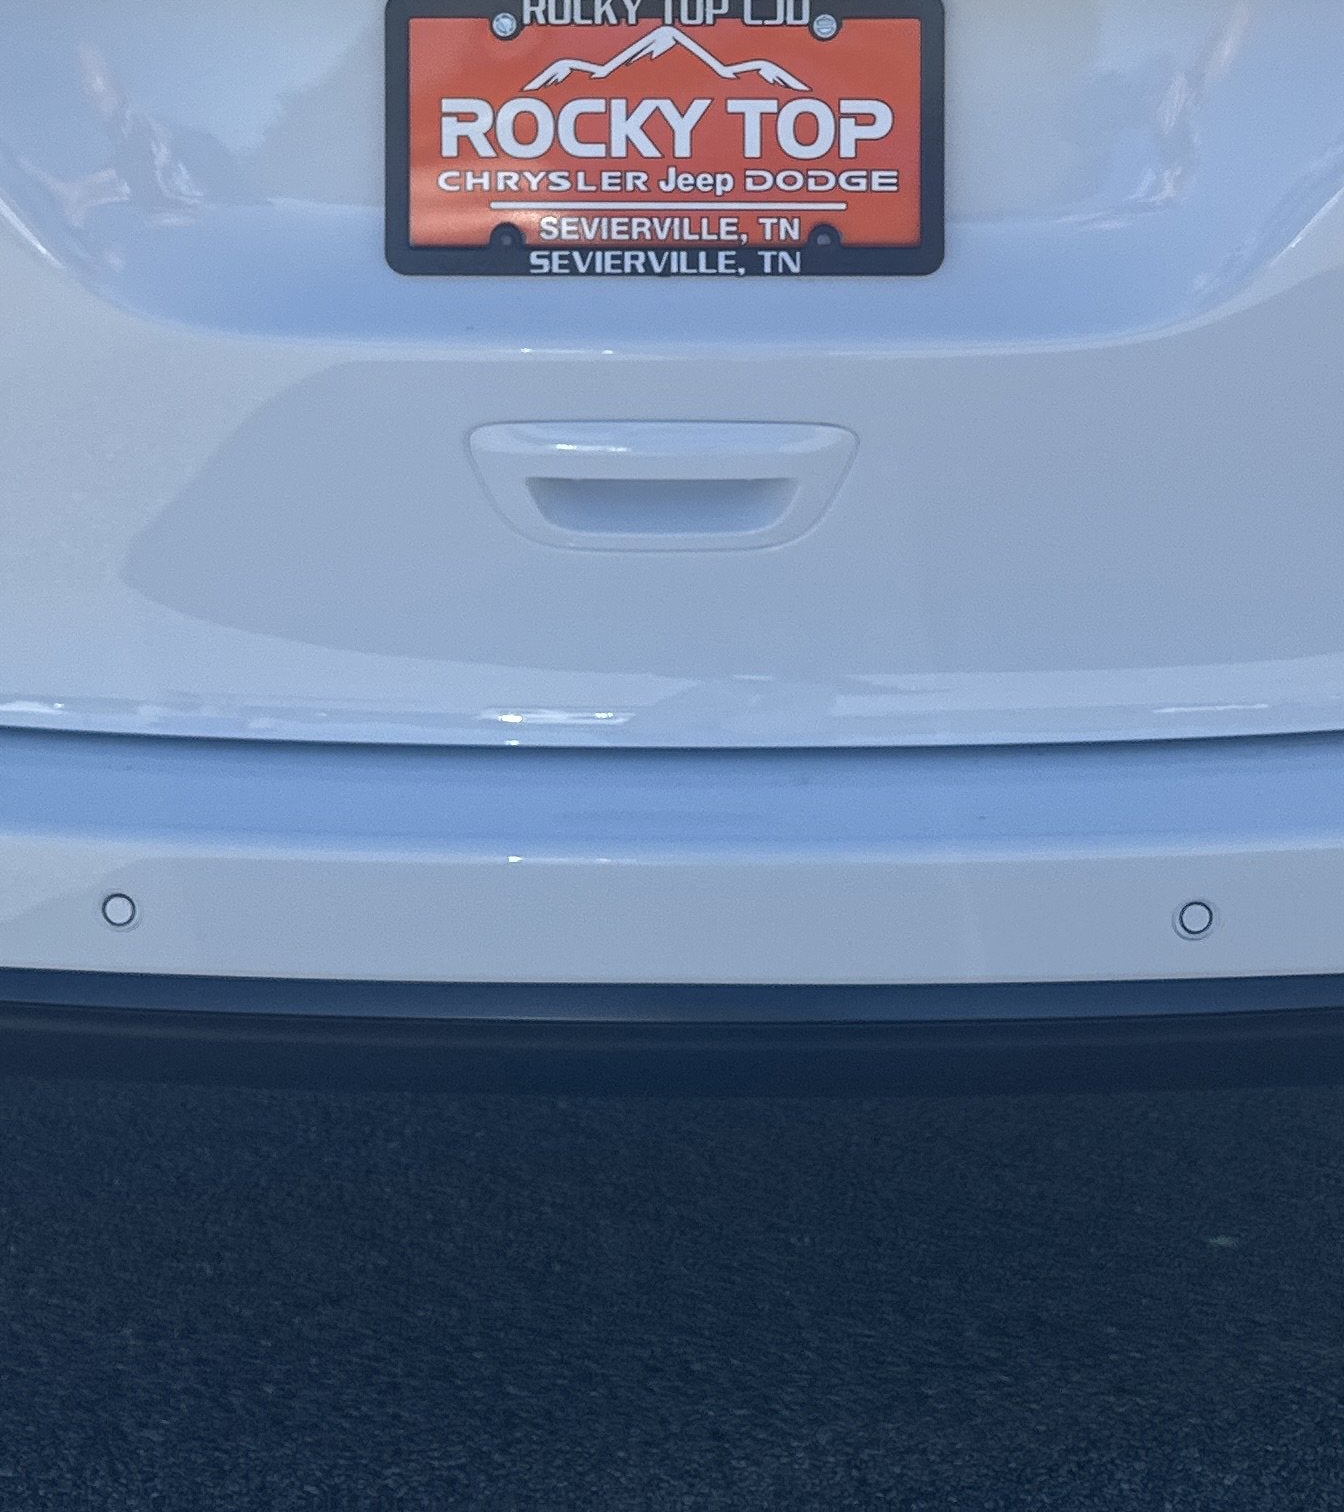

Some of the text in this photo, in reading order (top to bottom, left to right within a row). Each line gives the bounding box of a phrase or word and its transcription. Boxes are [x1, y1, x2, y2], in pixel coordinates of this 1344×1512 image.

[440, 97, 895, 159] ROCKY TOP
[437, 167, 899, 196] CHRYSLER Jeep DODGE
[539, 216, 801, 244] SEVIERVILLE, TN
[529, 250, 802, 276] SEVIERVILLE, TN
